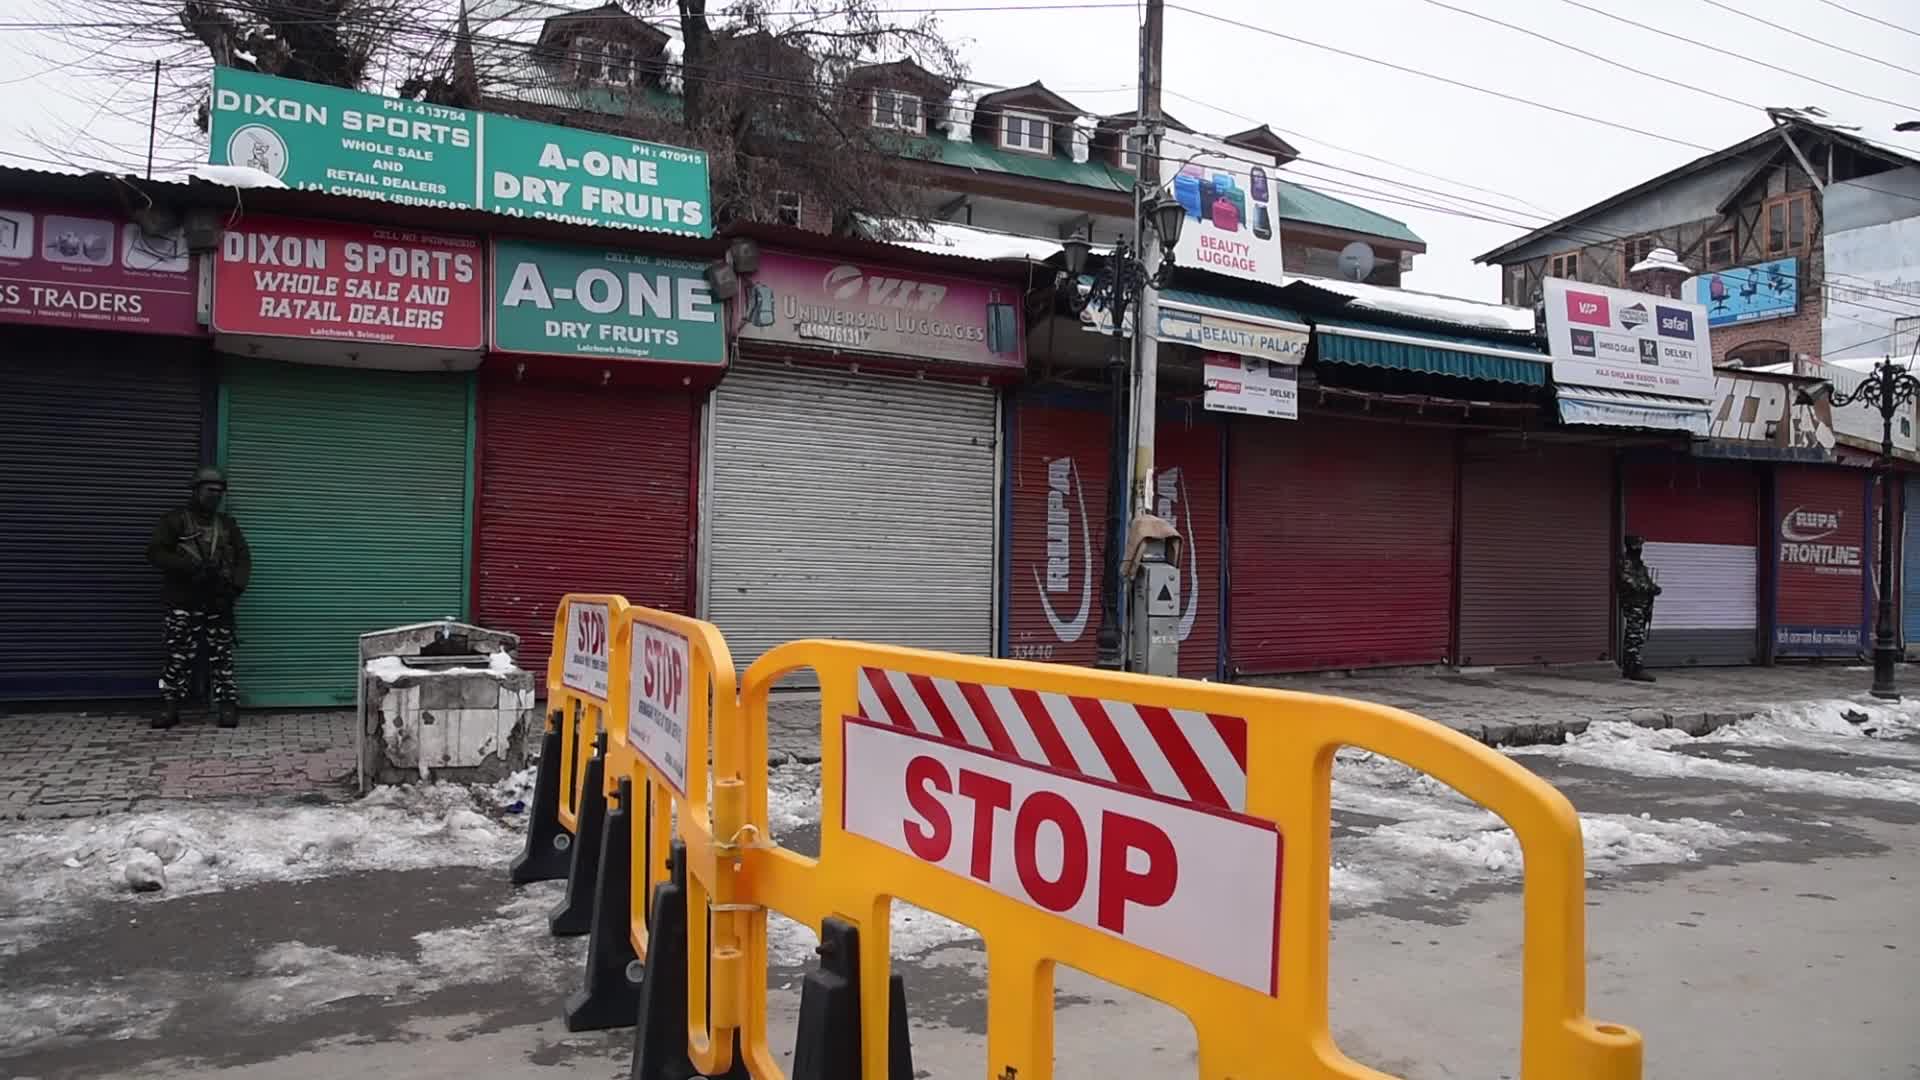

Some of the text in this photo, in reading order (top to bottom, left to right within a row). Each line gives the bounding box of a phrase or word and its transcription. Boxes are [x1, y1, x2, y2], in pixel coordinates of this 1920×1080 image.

[216, 88, 470, 148] DIXON SPORTS
[383, 99, 403, 111] PH
[414, 104, 466, 122] 413754
[341, 137, 434, 162] WHOLE SALE
[632, 143, 650, 156] PH
[659, 149, 702, 165] 470915
[372, 159, 404, 172] AND
[539, 142, 659, 187] A-ONE
[326, 168, 447, 195] RETAIL DEALERS
[493, 171, 703, 226] DRY FRUITS
[223, 231, 473, 283] DIXON SPORTS
[1200, 235, 1250, 257] BEAUTY
[1196, 248, 1256, 273] LUGGAGE
[0, 284, 143, 314] S TRADERS
[254, 270, 450, 306] WHOLE SALE AND
[503, 262, 716, 323] A-ONE
[866, 276, 948, 312] VIP
[259, 297, 444, 330] RATAIL DEALERS
[1578, 301, 1598, 315] VIP
[545, 320, 679, 345] DRY FRUITS
[1662, 316, 1689, 332] safari
[1202, 326, 1307, 357] BEAUTY PALACE
[1664, 347, 1692, 360] DELSEY
[1269, 388, 1296, 400] DELSEY
[1047, 457, 1070, 592] RUPA
[1795, 511, 1838, 529] RUPA
[1779, 543, 1861, 566] FRONTLINE
[578, 608, 606, 657] STOP
[643, 634, 683, 716] STOP
[903, 754, 1179, 935] STOP
